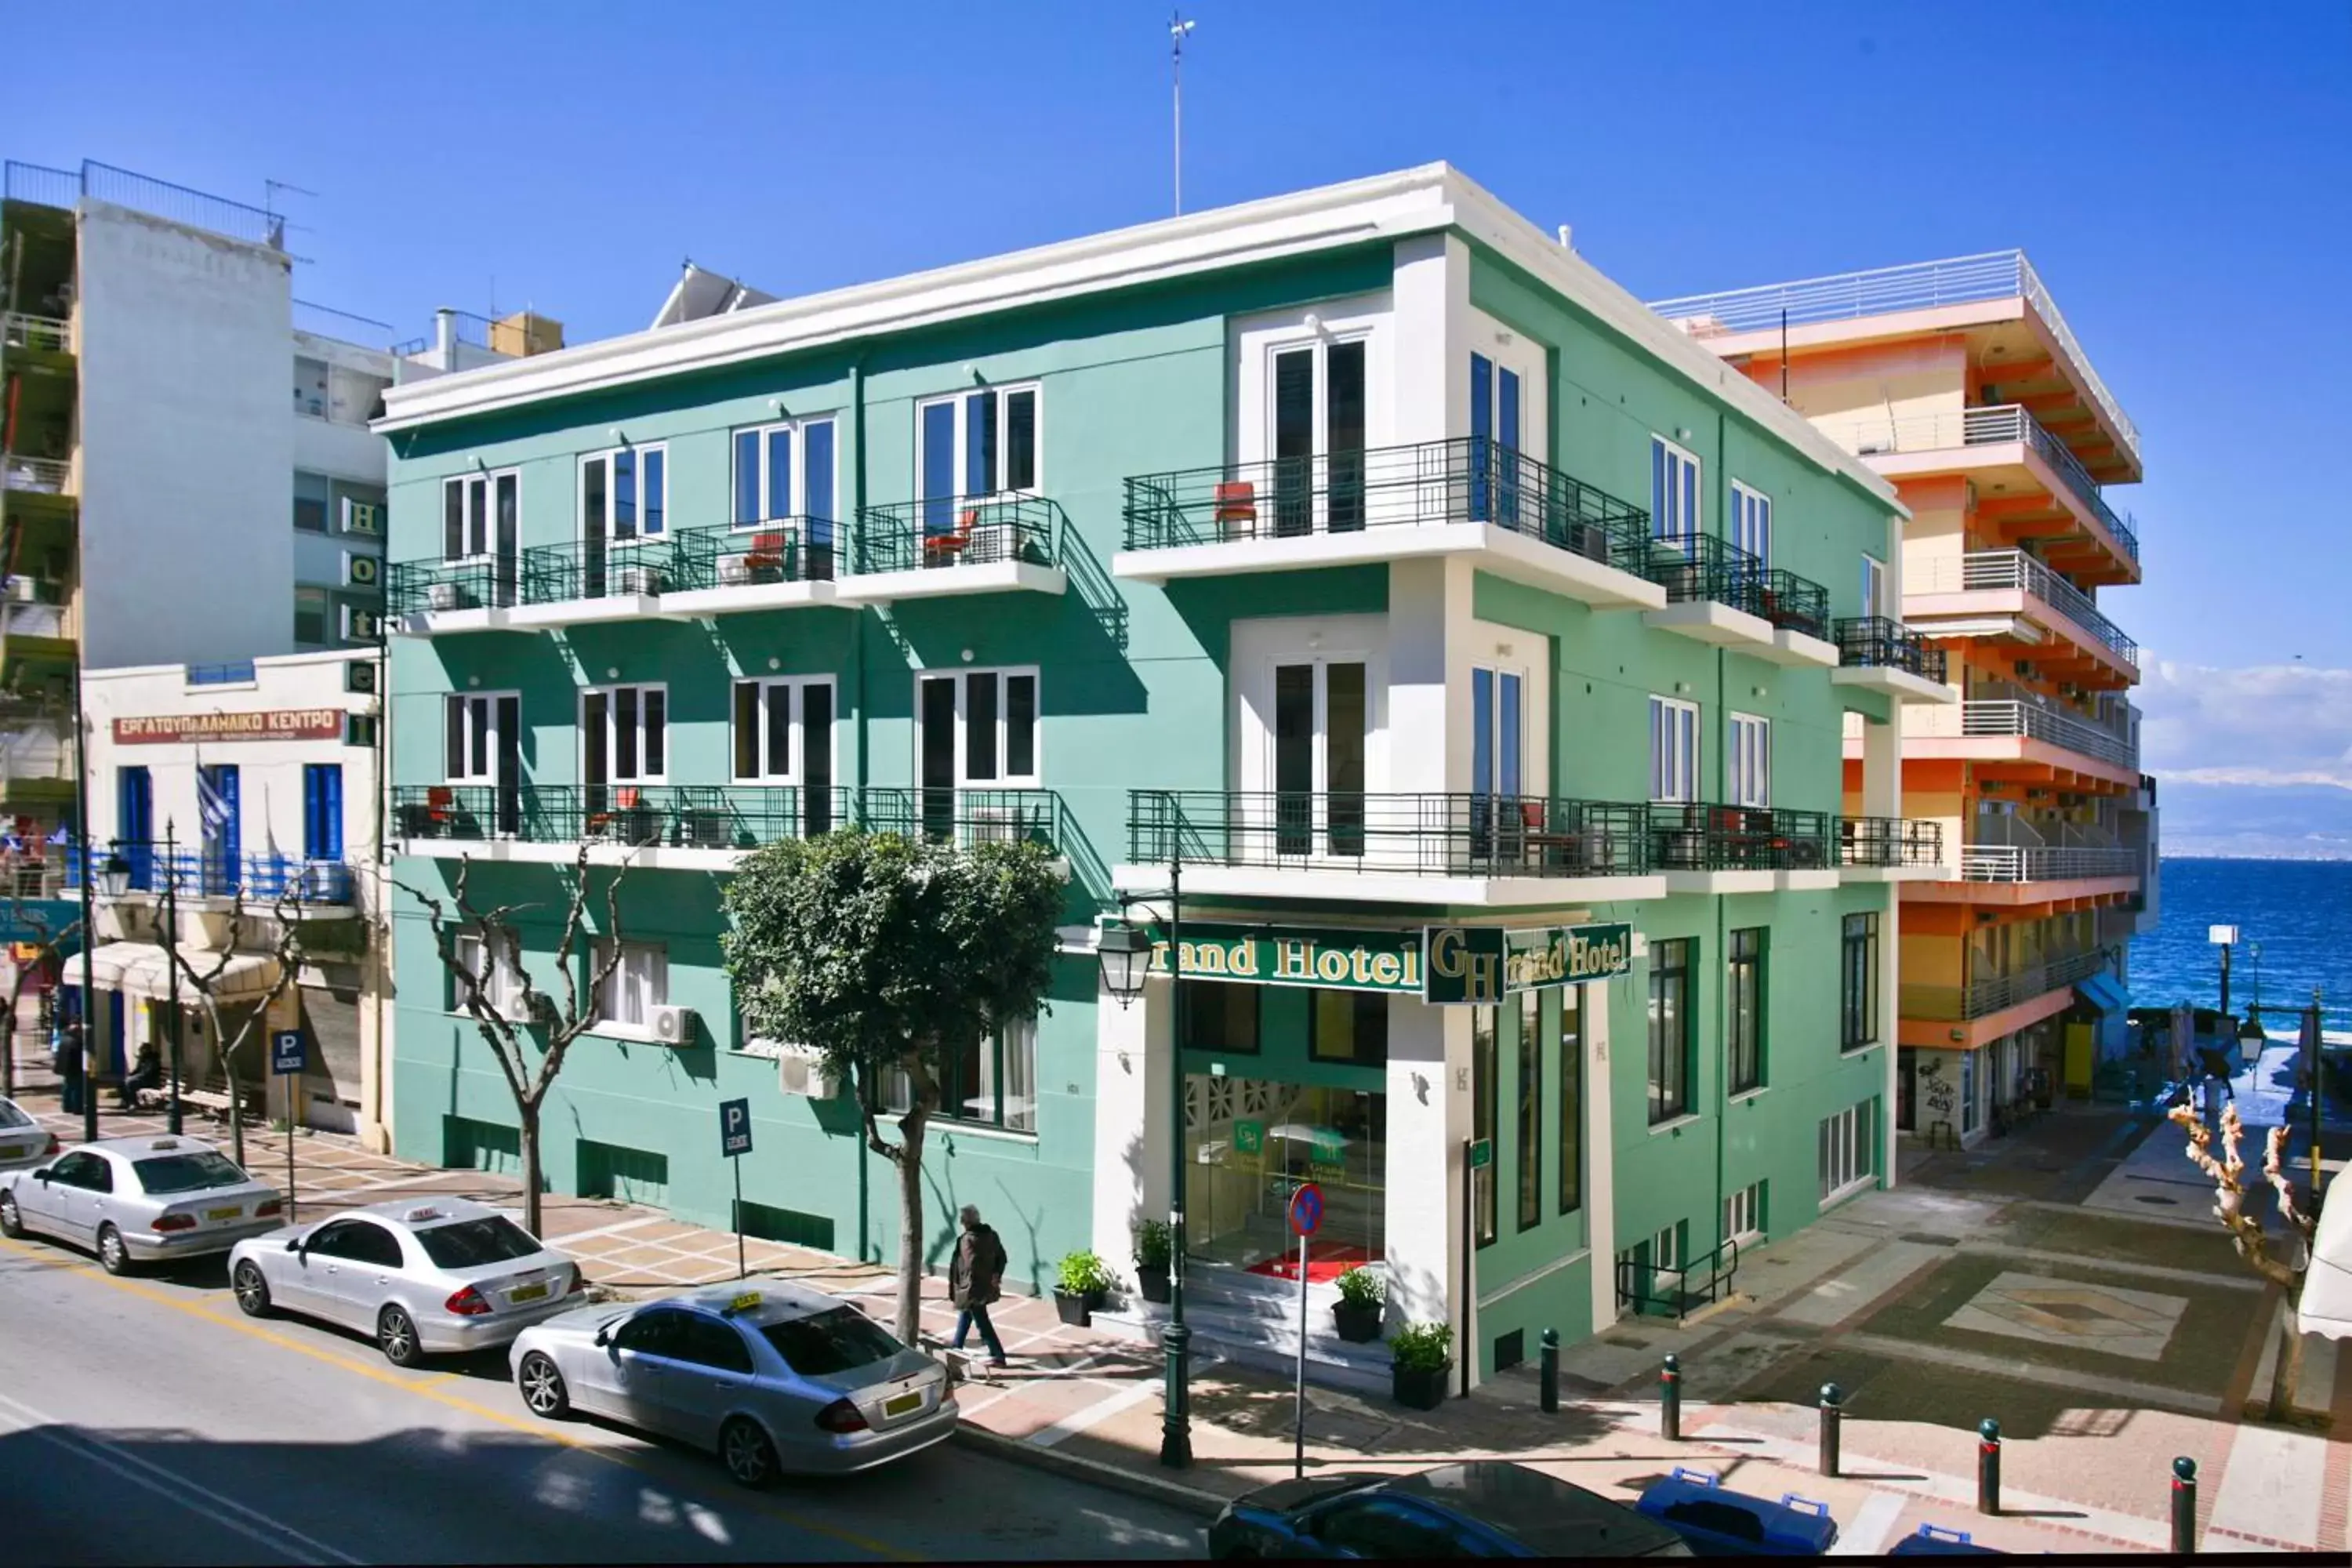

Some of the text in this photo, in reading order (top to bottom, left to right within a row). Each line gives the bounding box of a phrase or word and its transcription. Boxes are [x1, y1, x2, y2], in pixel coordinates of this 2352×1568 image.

[268, 710, 334, 731] ΚΕΝΤΡΟ
[1147, 932, 1421, 986] rand Hotel
[1569, 931, 1628, 978] Hotel
[281, 1034, 297, 1055] P
[728, 1107, 742, 1134] P
